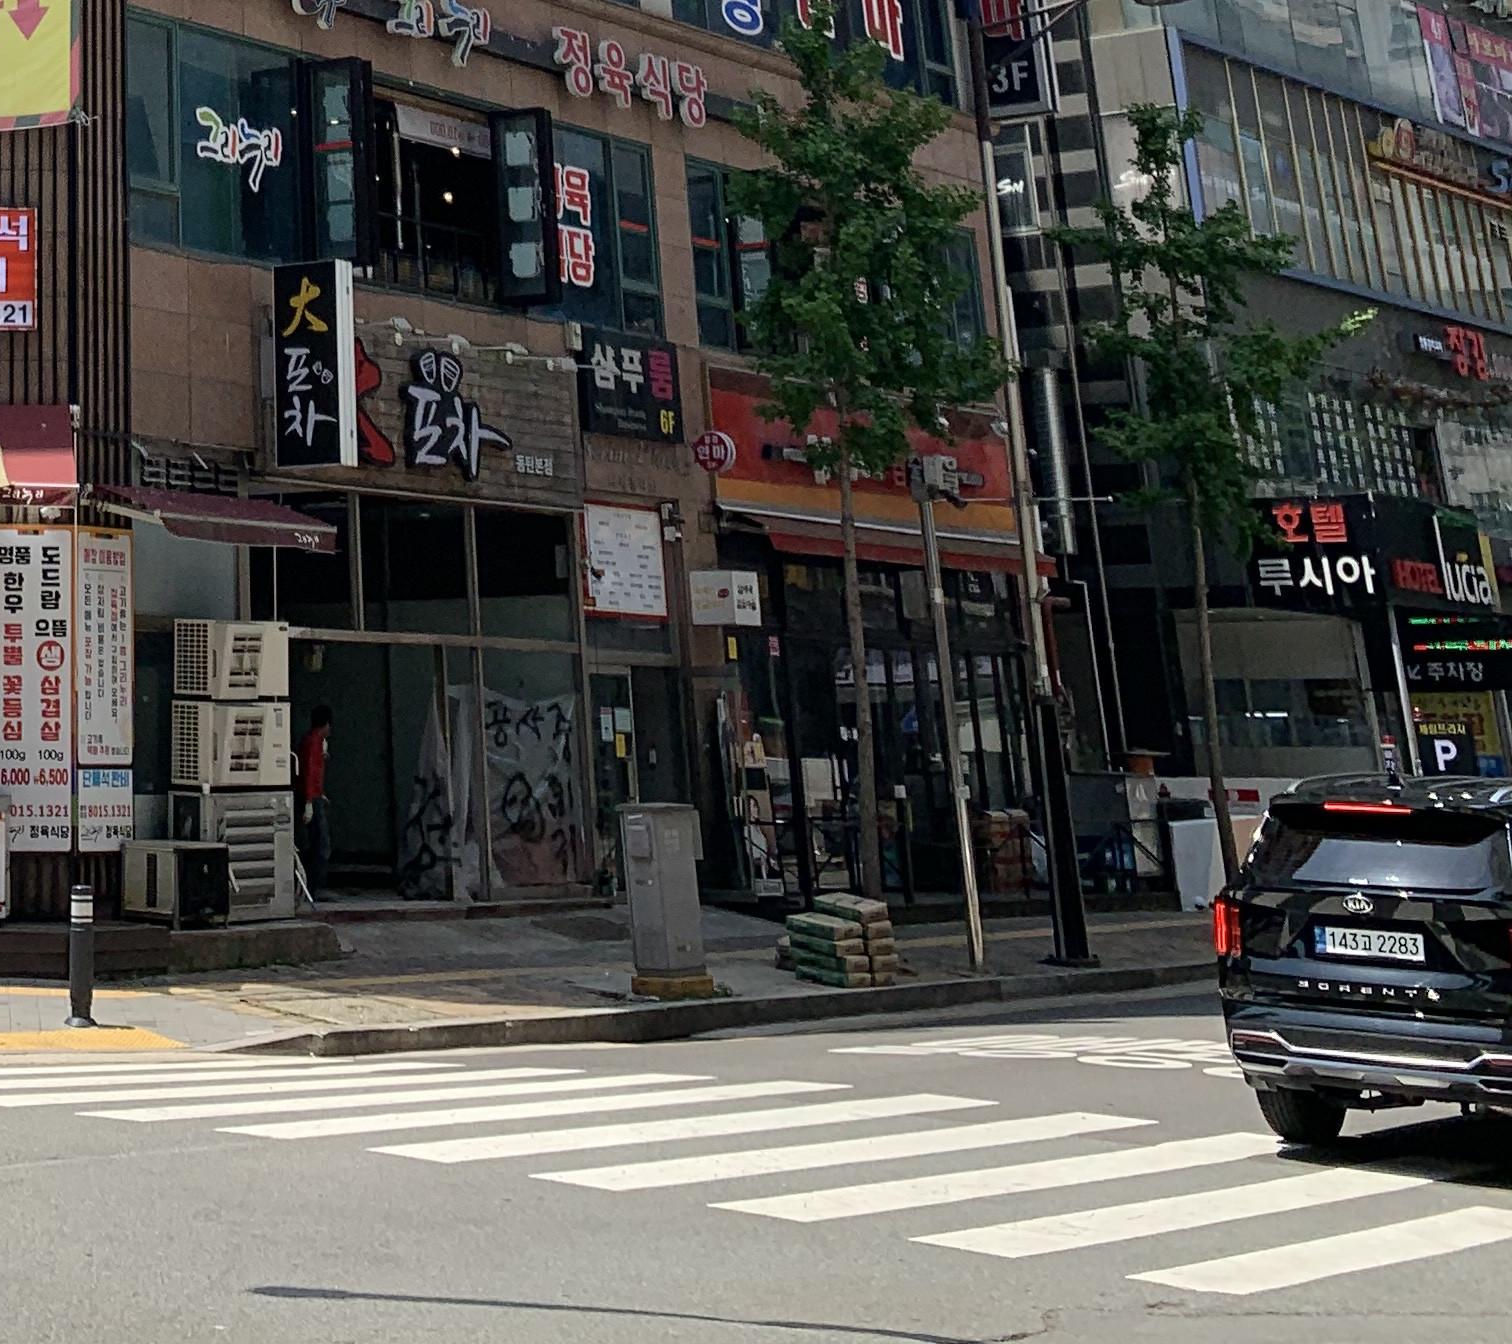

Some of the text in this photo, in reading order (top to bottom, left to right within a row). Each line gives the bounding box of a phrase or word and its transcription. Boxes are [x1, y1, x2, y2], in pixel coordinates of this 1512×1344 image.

[552, 25, 707, 130] 정육식당
[991, 61, 1029, 95] 3F
[590, 343, 675, 402] 샴푸룸
[659, 408, 676, 436] 6F
[696, 444, 727, 462] 안마
[1272, 501, 1348, 544] 호텔
[3, 571, 25, 615] 한우
[1257, 555, 1377, 597] 루시아
[34, 545, 68, 742] 도드람 으뜸 삼겹살
[2, 674, 24, 742] 꽃등심
[0, 748, 26, 762] 100g
[37, 748, 64, 762] 100g
[1433, 738, 1458, 773] P
[29, 824, 70, 840] 정육식당
[1347, 897, 1371, 912] KIA
[1376, 933, 1421, 957] 2283
